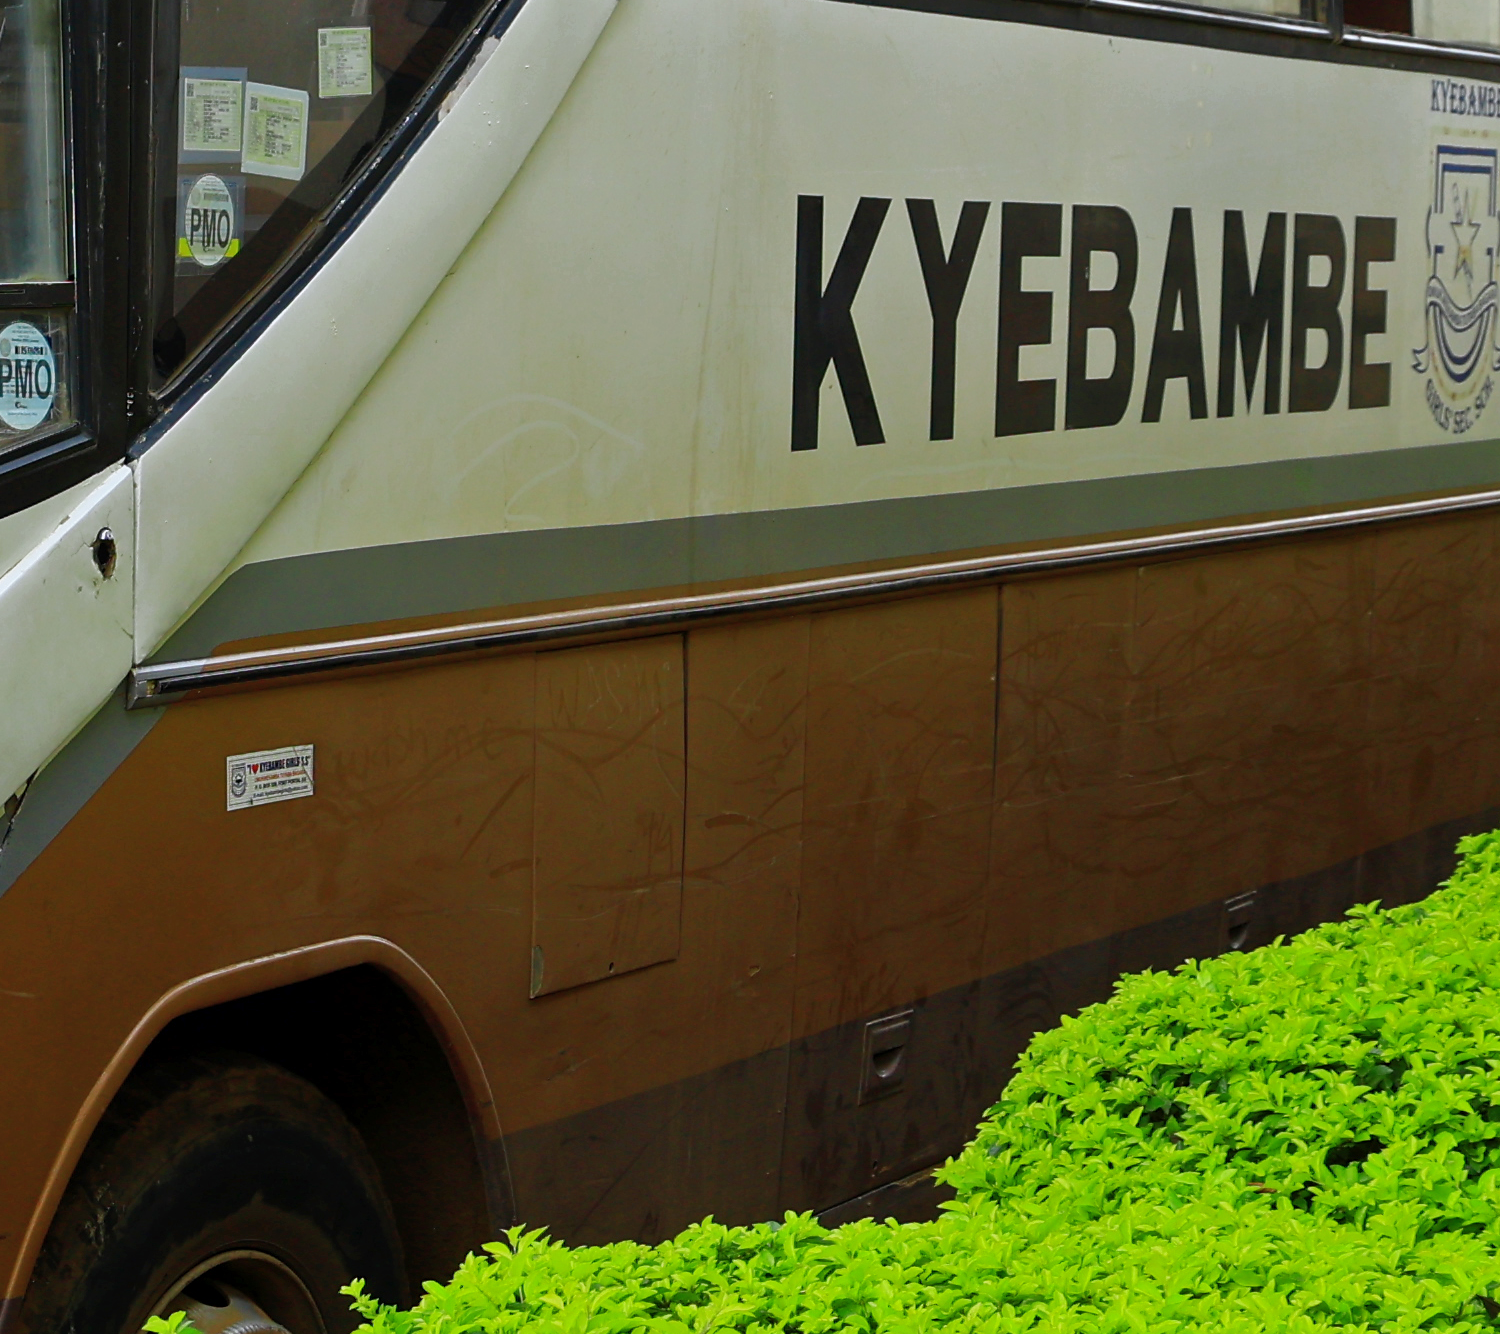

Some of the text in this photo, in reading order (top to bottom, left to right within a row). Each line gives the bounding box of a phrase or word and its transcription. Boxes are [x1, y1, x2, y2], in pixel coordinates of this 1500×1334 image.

[190, 208, 231, 248] PMO
[790, 194, 1397, 453] KYEBAMBE
[0, 358, 53, 400] PMO
